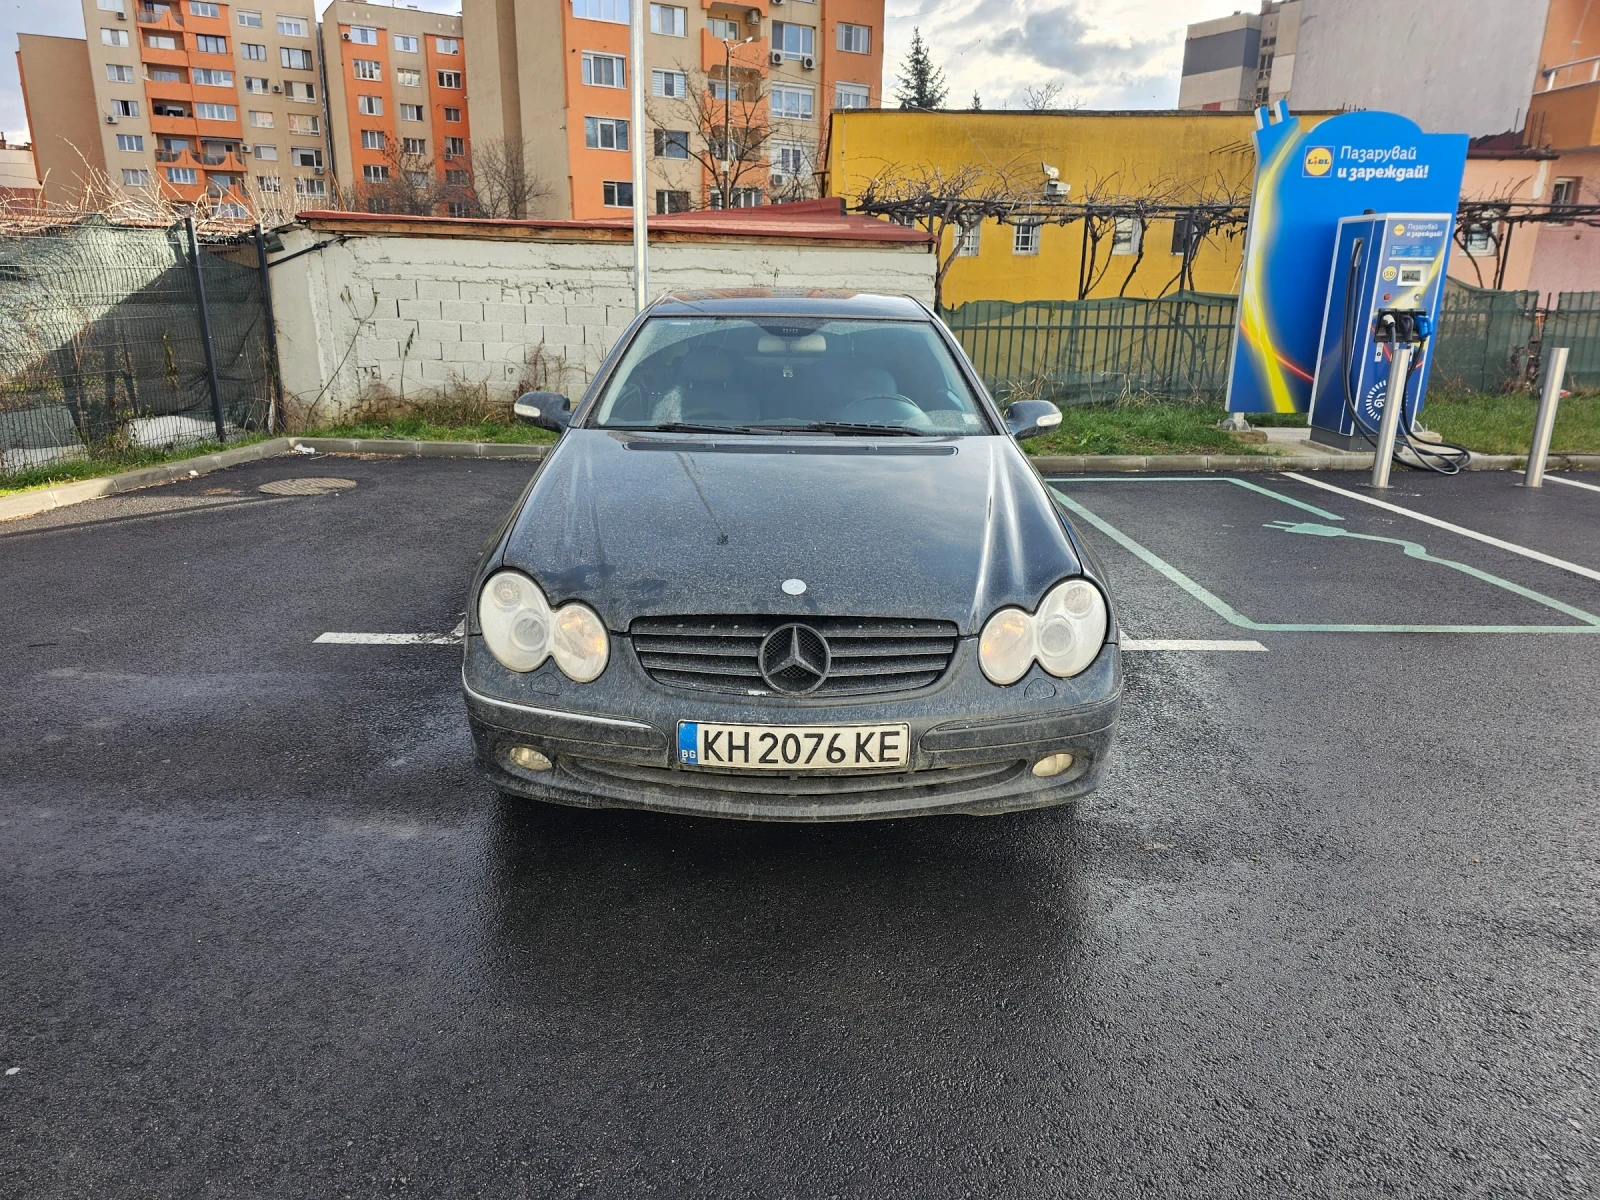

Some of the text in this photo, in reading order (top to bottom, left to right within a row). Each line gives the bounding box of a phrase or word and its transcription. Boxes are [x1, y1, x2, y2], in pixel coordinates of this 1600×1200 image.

[1340, 145, 1417, 162] Пазарувай
[1337, 164, 1429, 181] и зареждай!
[681, 749, 697, 759] BG
